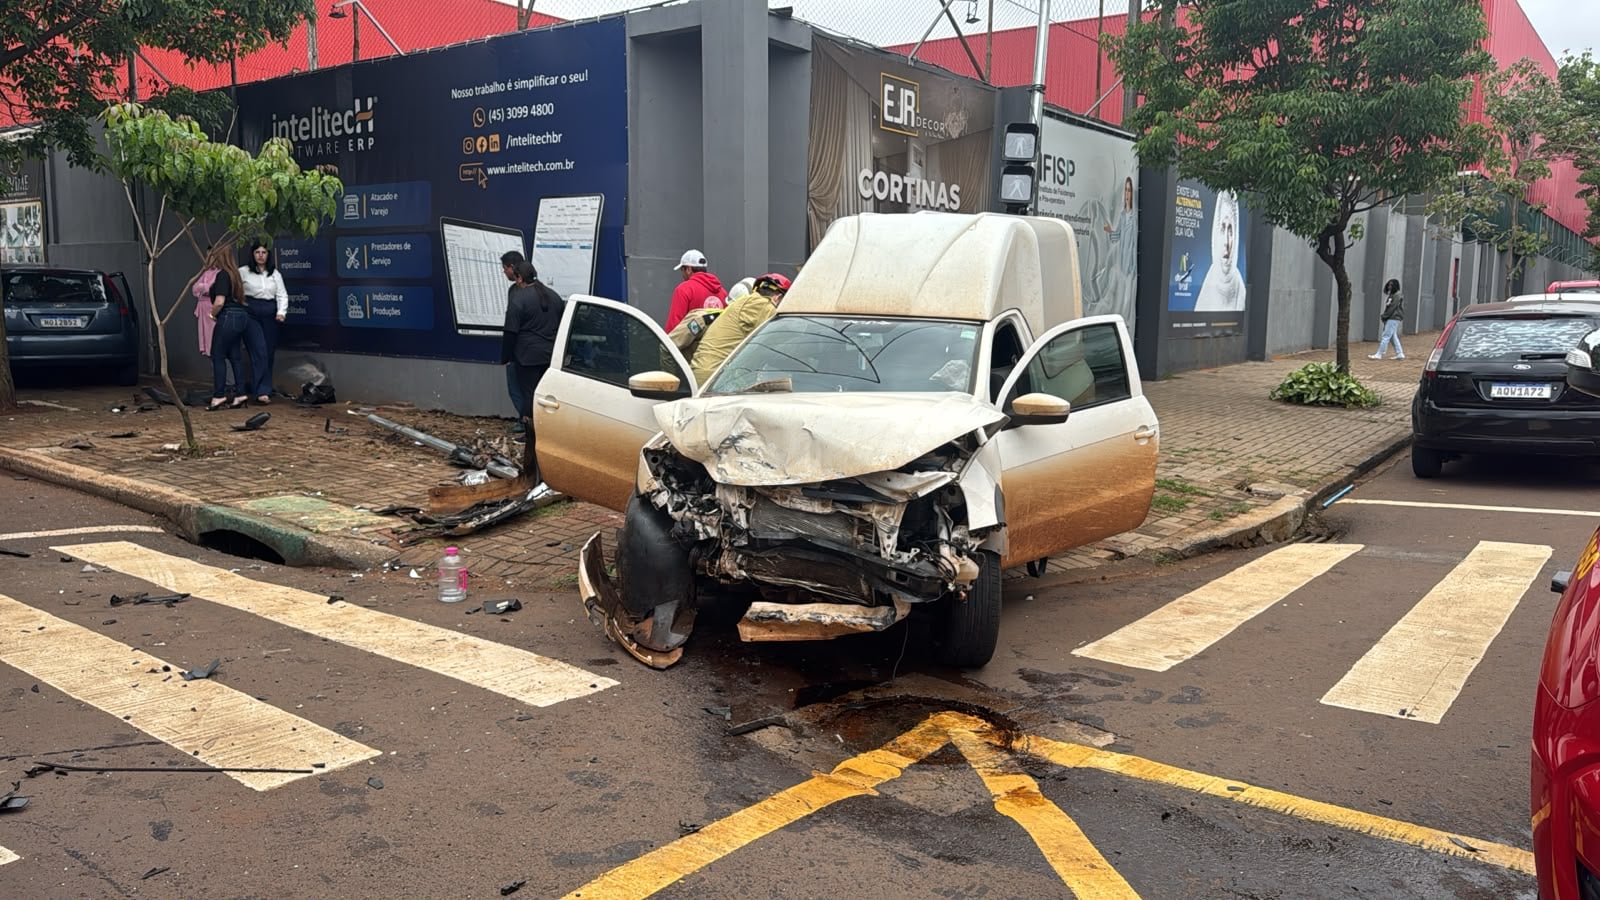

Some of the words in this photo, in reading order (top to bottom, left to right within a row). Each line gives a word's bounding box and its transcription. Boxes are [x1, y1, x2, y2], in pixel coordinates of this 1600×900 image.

[451, 88, 474, 100] Nosso
[475, 81, 505, 96] trabalho
[507, 79, 513, 91] é
[514, 74, 559, 90] simplificar
[560, 76, 567, 84] o
[568, 69, 588, 84] seu!
[488, 107, 505, 124] (45)
[506, 106, 528, 120] 3099
[530, 102, 554, 116] 4800
[506, 131, 562, 150] /intelitechbr
[296, 141, 340, 157] TWARE
[348, 138, 374, 152] ERP
[487, 159, 575, 175] www.intelitech.com.br
[858, 168, 961, 211] CORTINAS
[370, 192, 394, 201] Atacado
[370, 208, 389, 216] Varejo
[371, 242, 402, 250] Prestadores
[404, 241, 411, 250] de
[280, 248, 299, 256] Suporte
[281, 261, 312, 270] especializado
[372, 257, 391, 266] Serviço
[372, 292, 398, 302] Indústrias
[372, 307, 401, 317] Produções
[1496, 388, 1544, 396] AQW1A72
